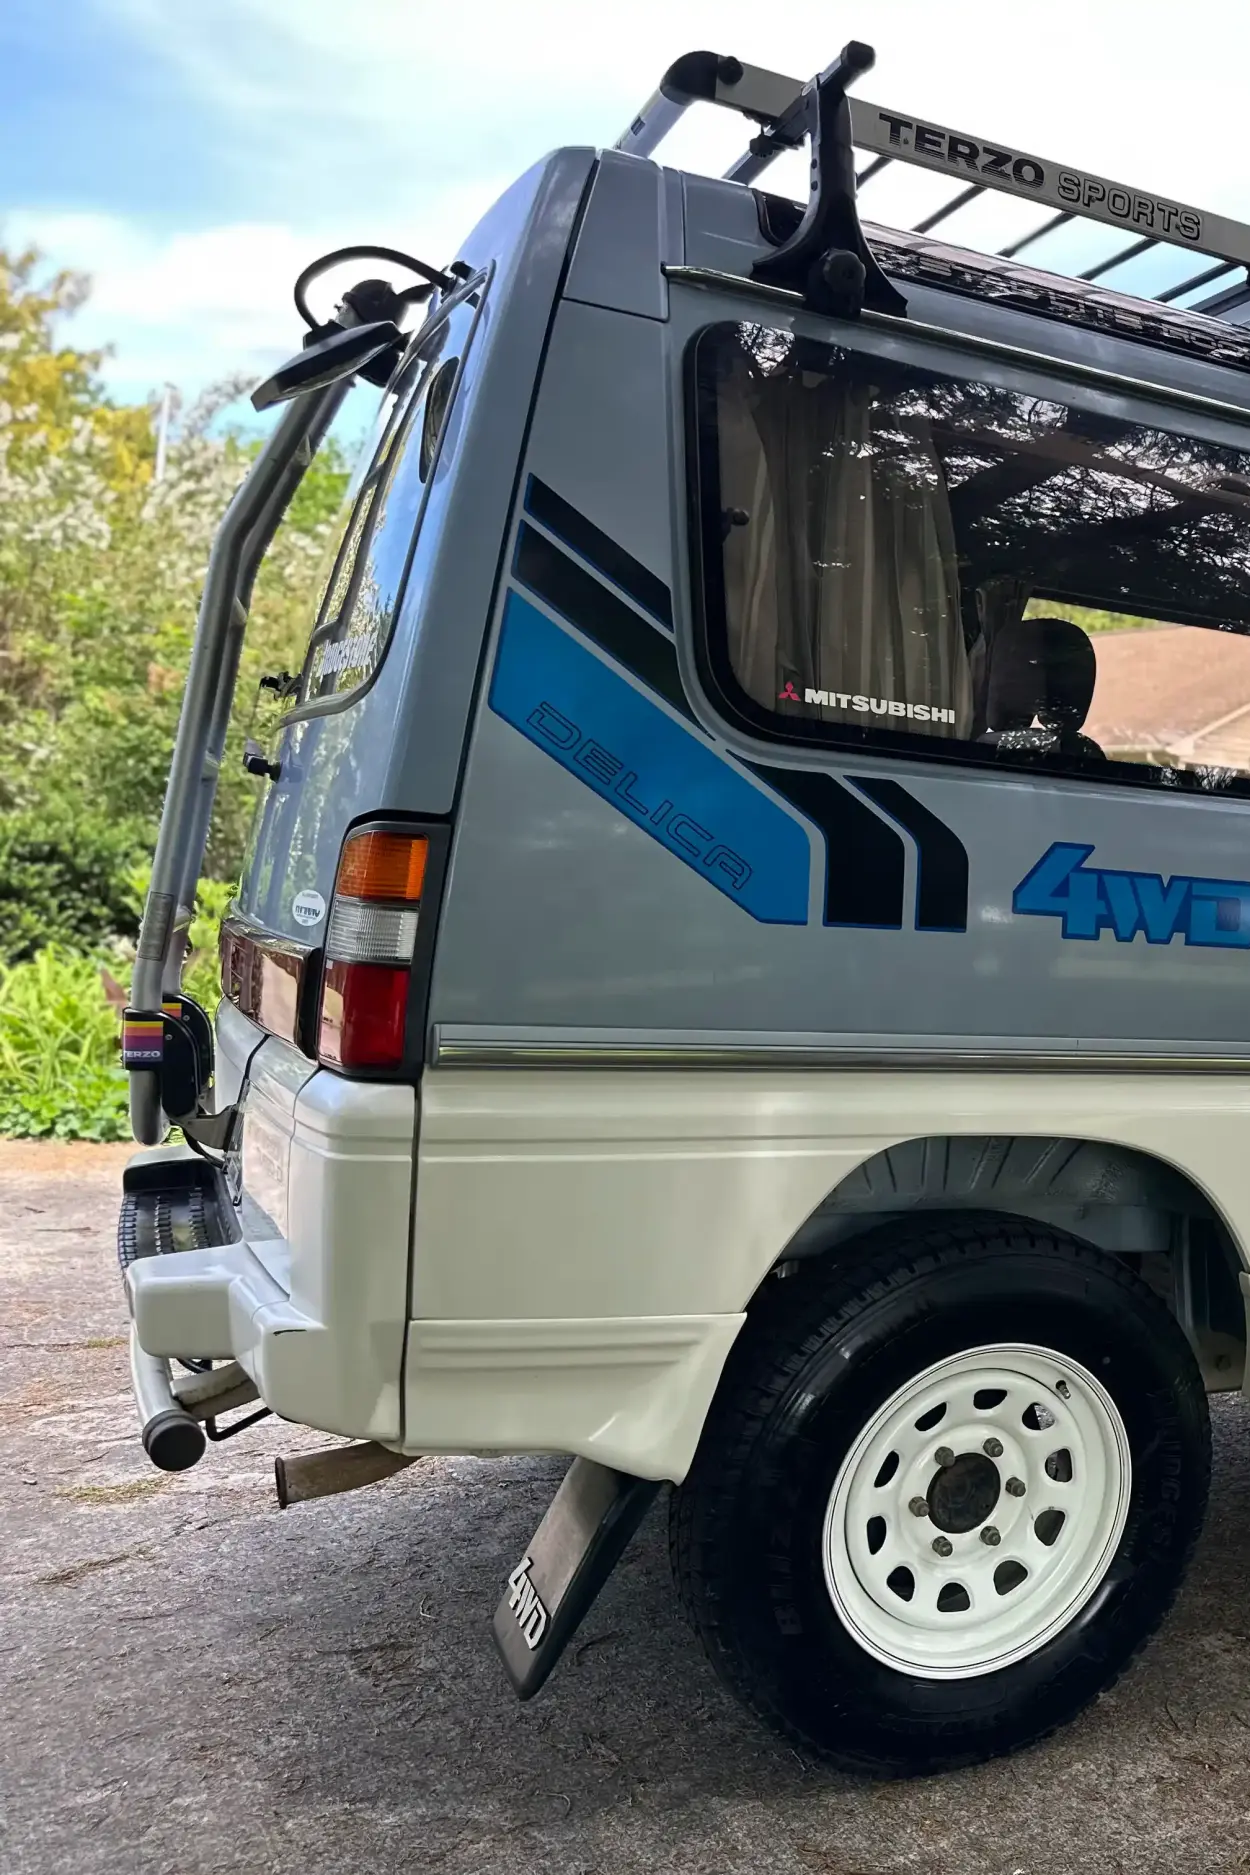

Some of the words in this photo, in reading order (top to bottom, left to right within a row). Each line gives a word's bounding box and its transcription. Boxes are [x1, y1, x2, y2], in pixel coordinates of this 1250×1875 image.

[879, 112, 1044, 189] TERZO
[1058, 171, 1200, 241] SPORTS
[804, 688, 955, 724] MITSUBISHI
[526, 701, 754, 890] DELICA
[508, 1557, 549, 1650] 4WD
